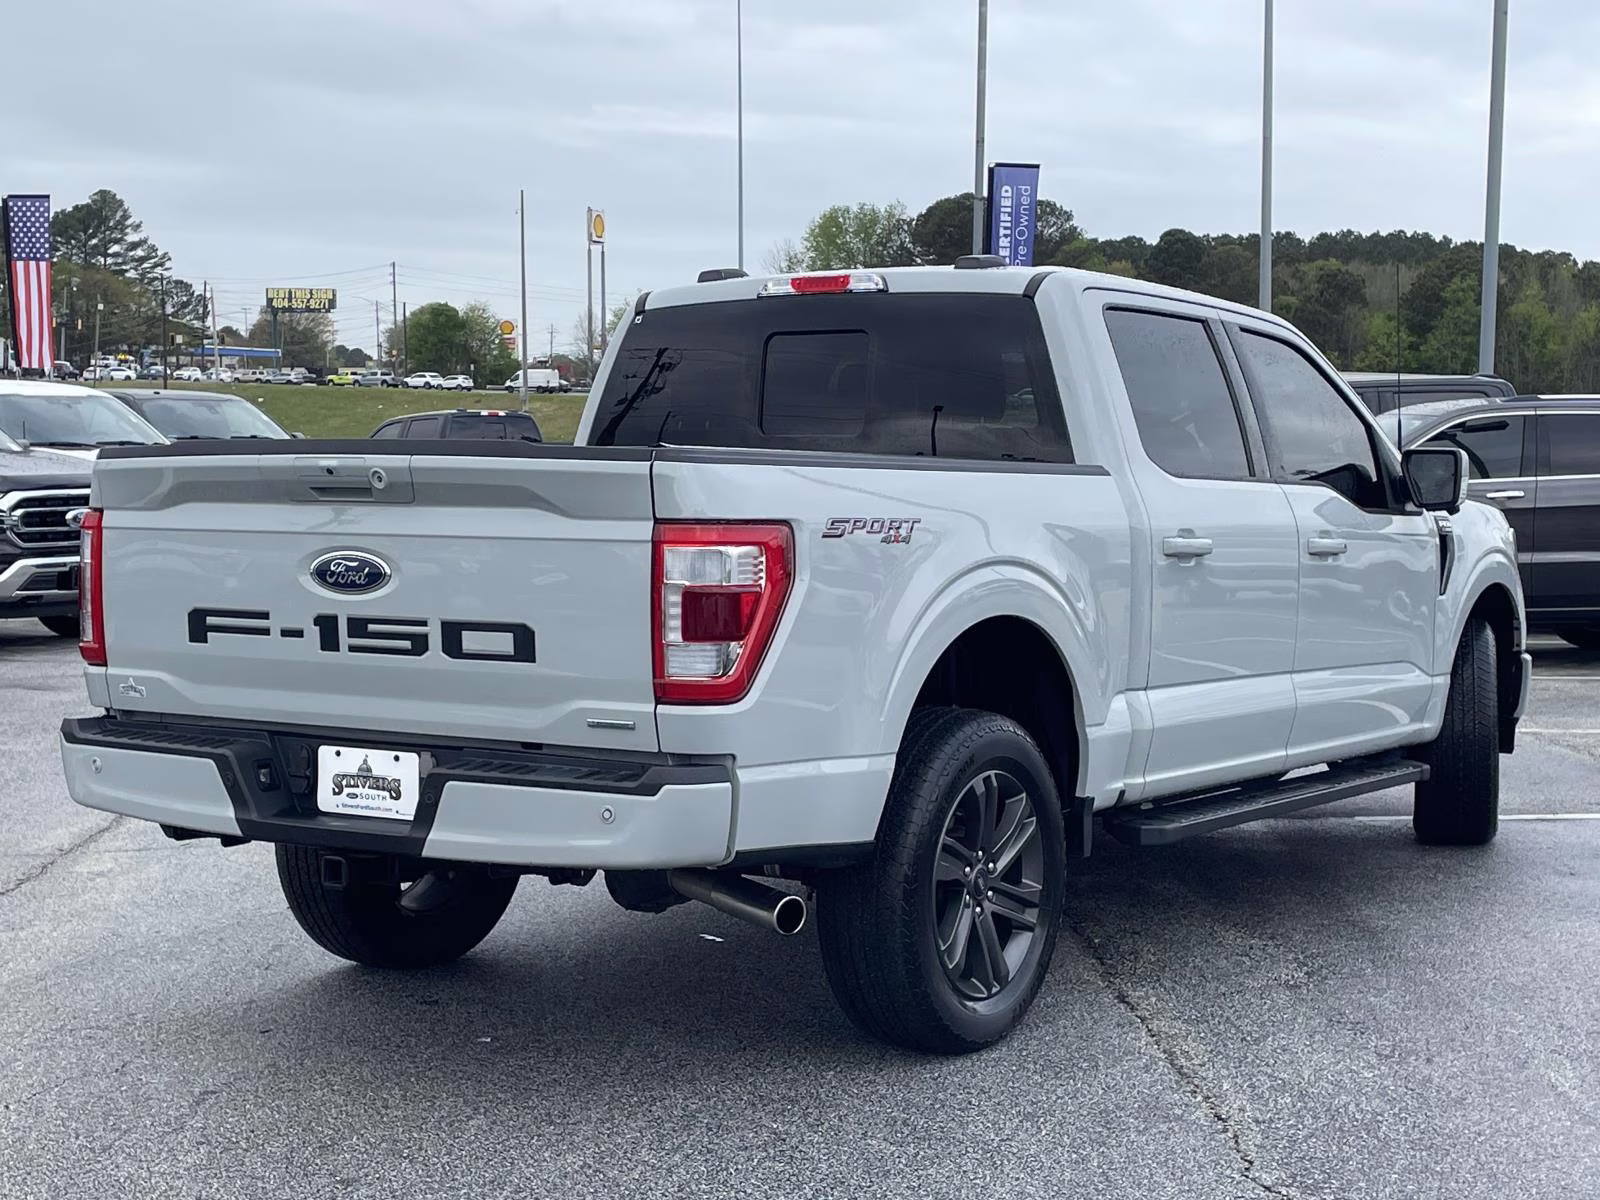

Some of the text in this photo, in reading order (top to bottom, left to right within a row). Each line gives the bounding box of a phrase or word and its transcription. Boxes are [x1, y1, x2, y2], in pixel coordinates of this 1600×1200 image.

[999, 185, 1012, 264] ERTIFIED
[267, 288, 333, 299] RENT THIS SIGN
[272, 298, 329, 309] 404-557-9271
[821, 517, 921, 538] SPORT
[326, 559, 369, 585] Ford
[188, 607, 536, 663] F-150
[332, 773, 402, 801] STIVERS
[359, 792, 388, 801] SOUTH
